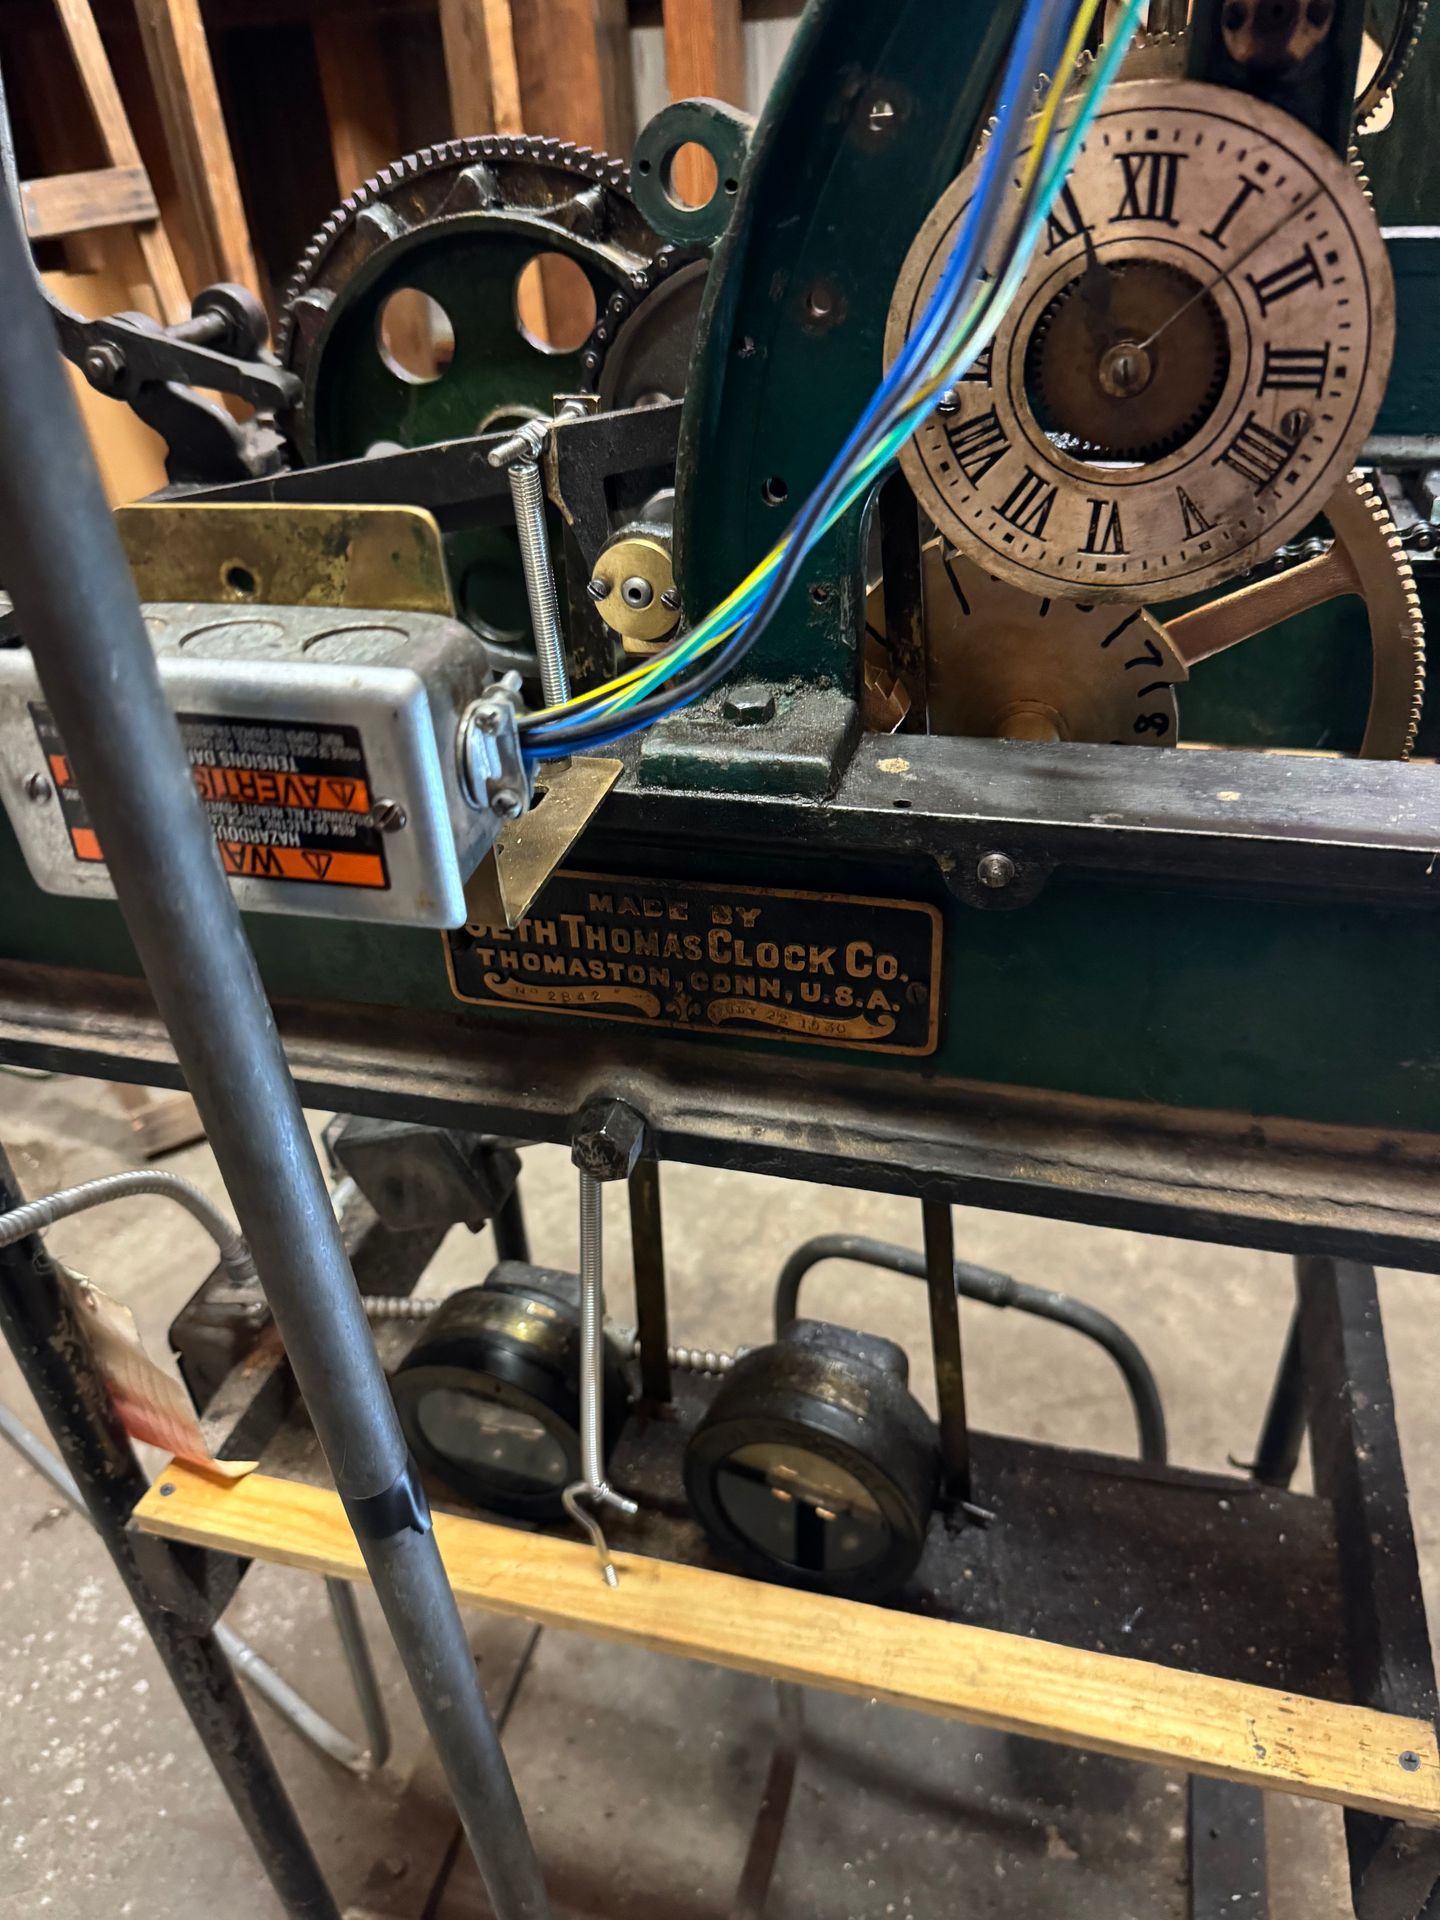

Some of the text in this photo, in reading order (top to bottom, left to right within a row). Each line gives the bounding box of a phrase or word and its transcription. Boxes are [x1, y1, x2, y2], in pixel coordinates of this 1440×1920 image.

[1108, 152, 1188, 227] XII
[1200, 174, 1264, 250] I
[1245, 242, 1326, 318] II
[1256, 341, 1331, 399] III
[943, 402, 1013, 491] VIII
[991, 465, 1060, 542] VII
[1077, 498, 1131, 555] VI
[1176, 486, 1218, 542] V
[211, 824, 301, 847] HAZARDOU
[588, 893, 762, 928] MADE BY
[559, 913, 703, 960] THOMAS
[707, 927, 837, 976] CLOCK
[800, 981, 901, 1013] U.S.A.
